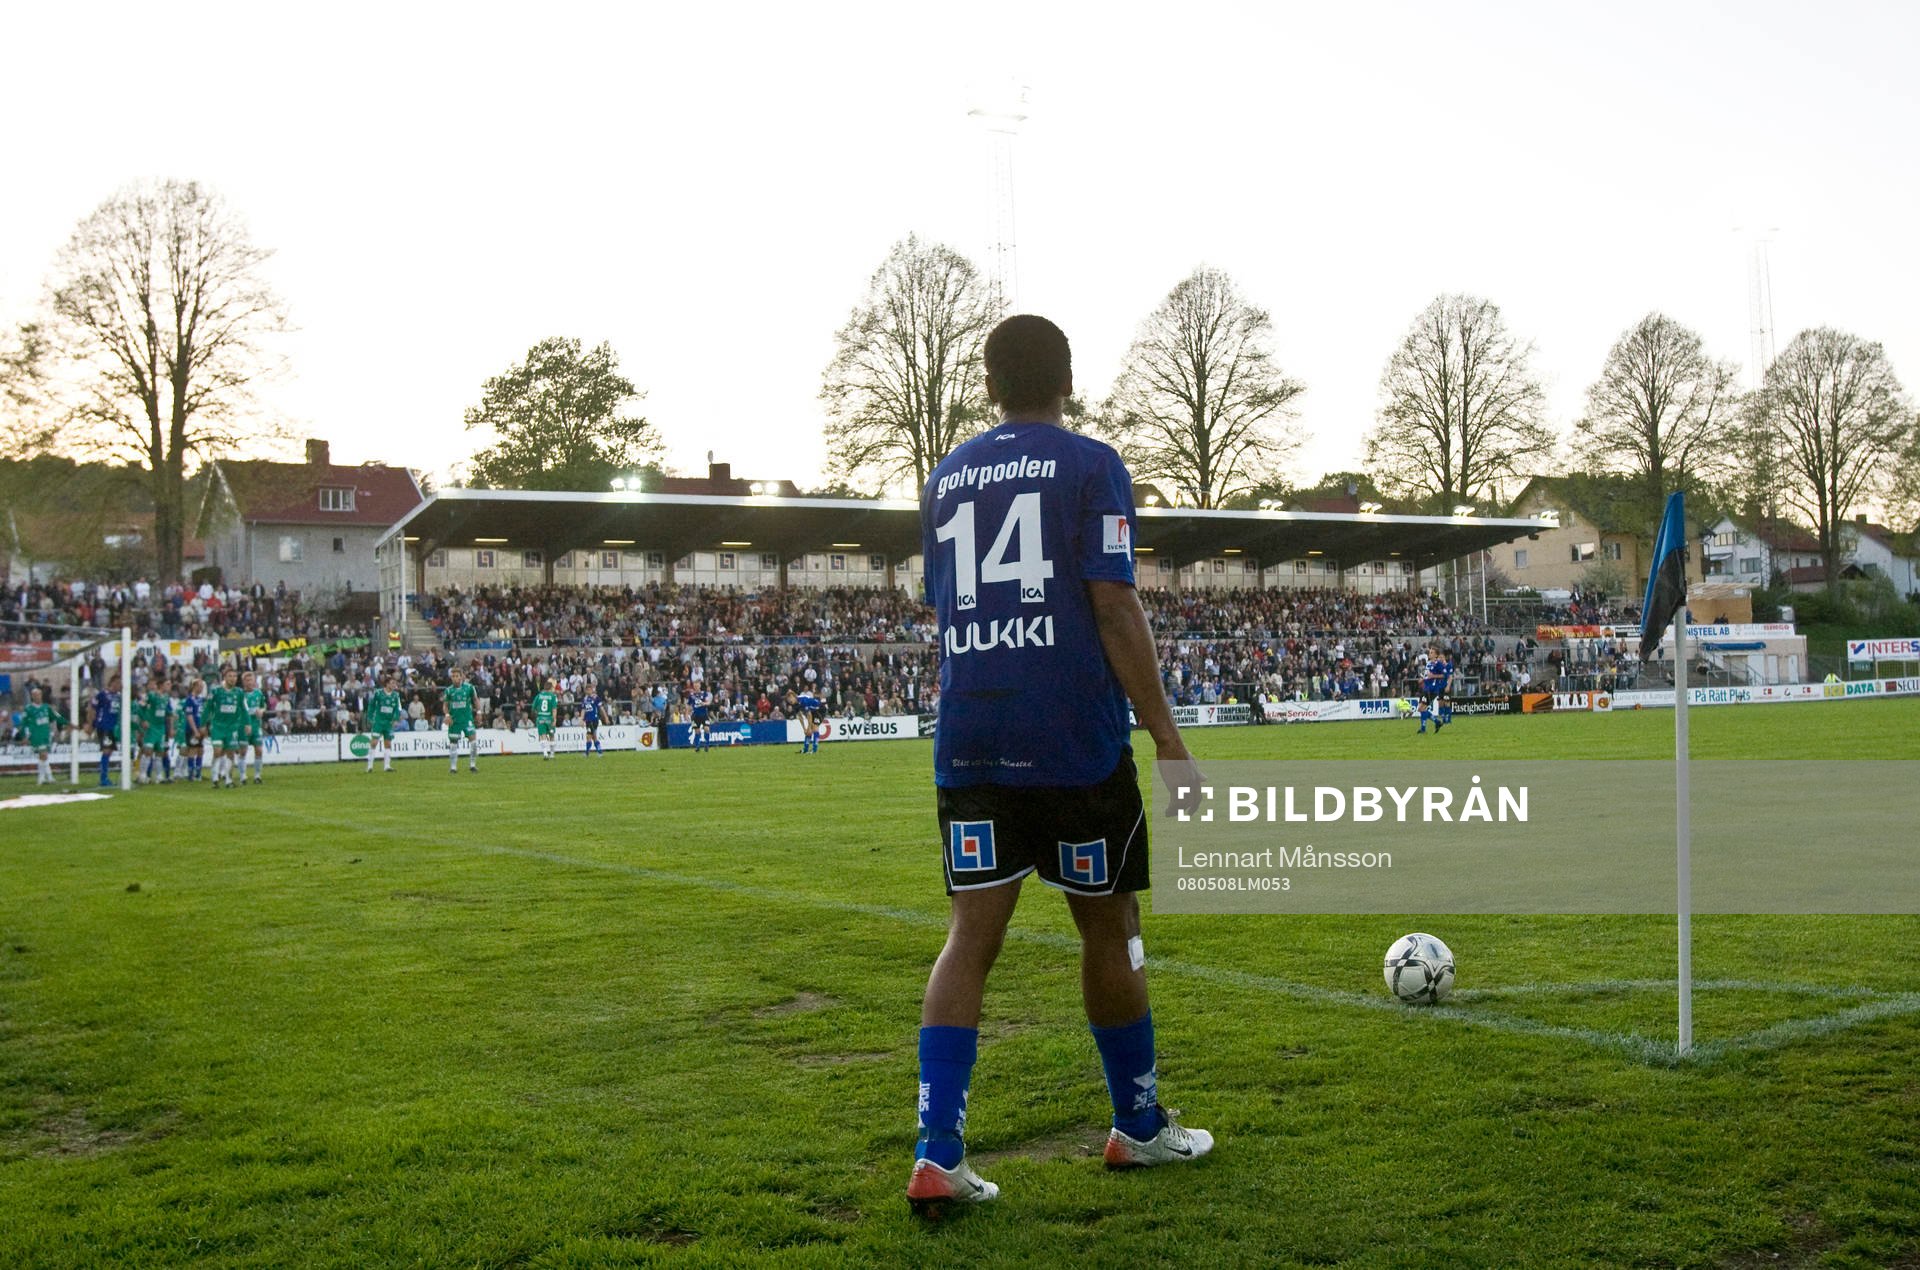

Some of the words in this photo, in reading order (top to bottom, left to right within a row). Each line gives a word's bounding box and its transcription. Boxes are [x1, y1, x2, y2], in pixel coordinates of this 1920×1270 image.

[937, 455, 1057, 500] golvpoolen
[935, 492, 1055, 611] 14
[1022, 587, 1044, 599] ICA
[958, 594, 976, 606] ICA
[1686, 626, 1718, 637] NISTEEL
[1719, 626, 1730, 636] AB
[1867, 640, 1920, 655] INTERS
[1695, 687, 1707, 702] På
[1709, 687, 1727, 702] Rätt
[1729, 688, 1751, 702] Plats
[1847, 683, 1875, 695] DATA
[541, 700, 549, 712] 8
[1172, 708, 1199, 716] ANPENAD
[1360, 700, 1390, 715] KPMG
[1174, 716, 1199, 724] ANNING
[839, 722, 898, 736] SWEBUS
